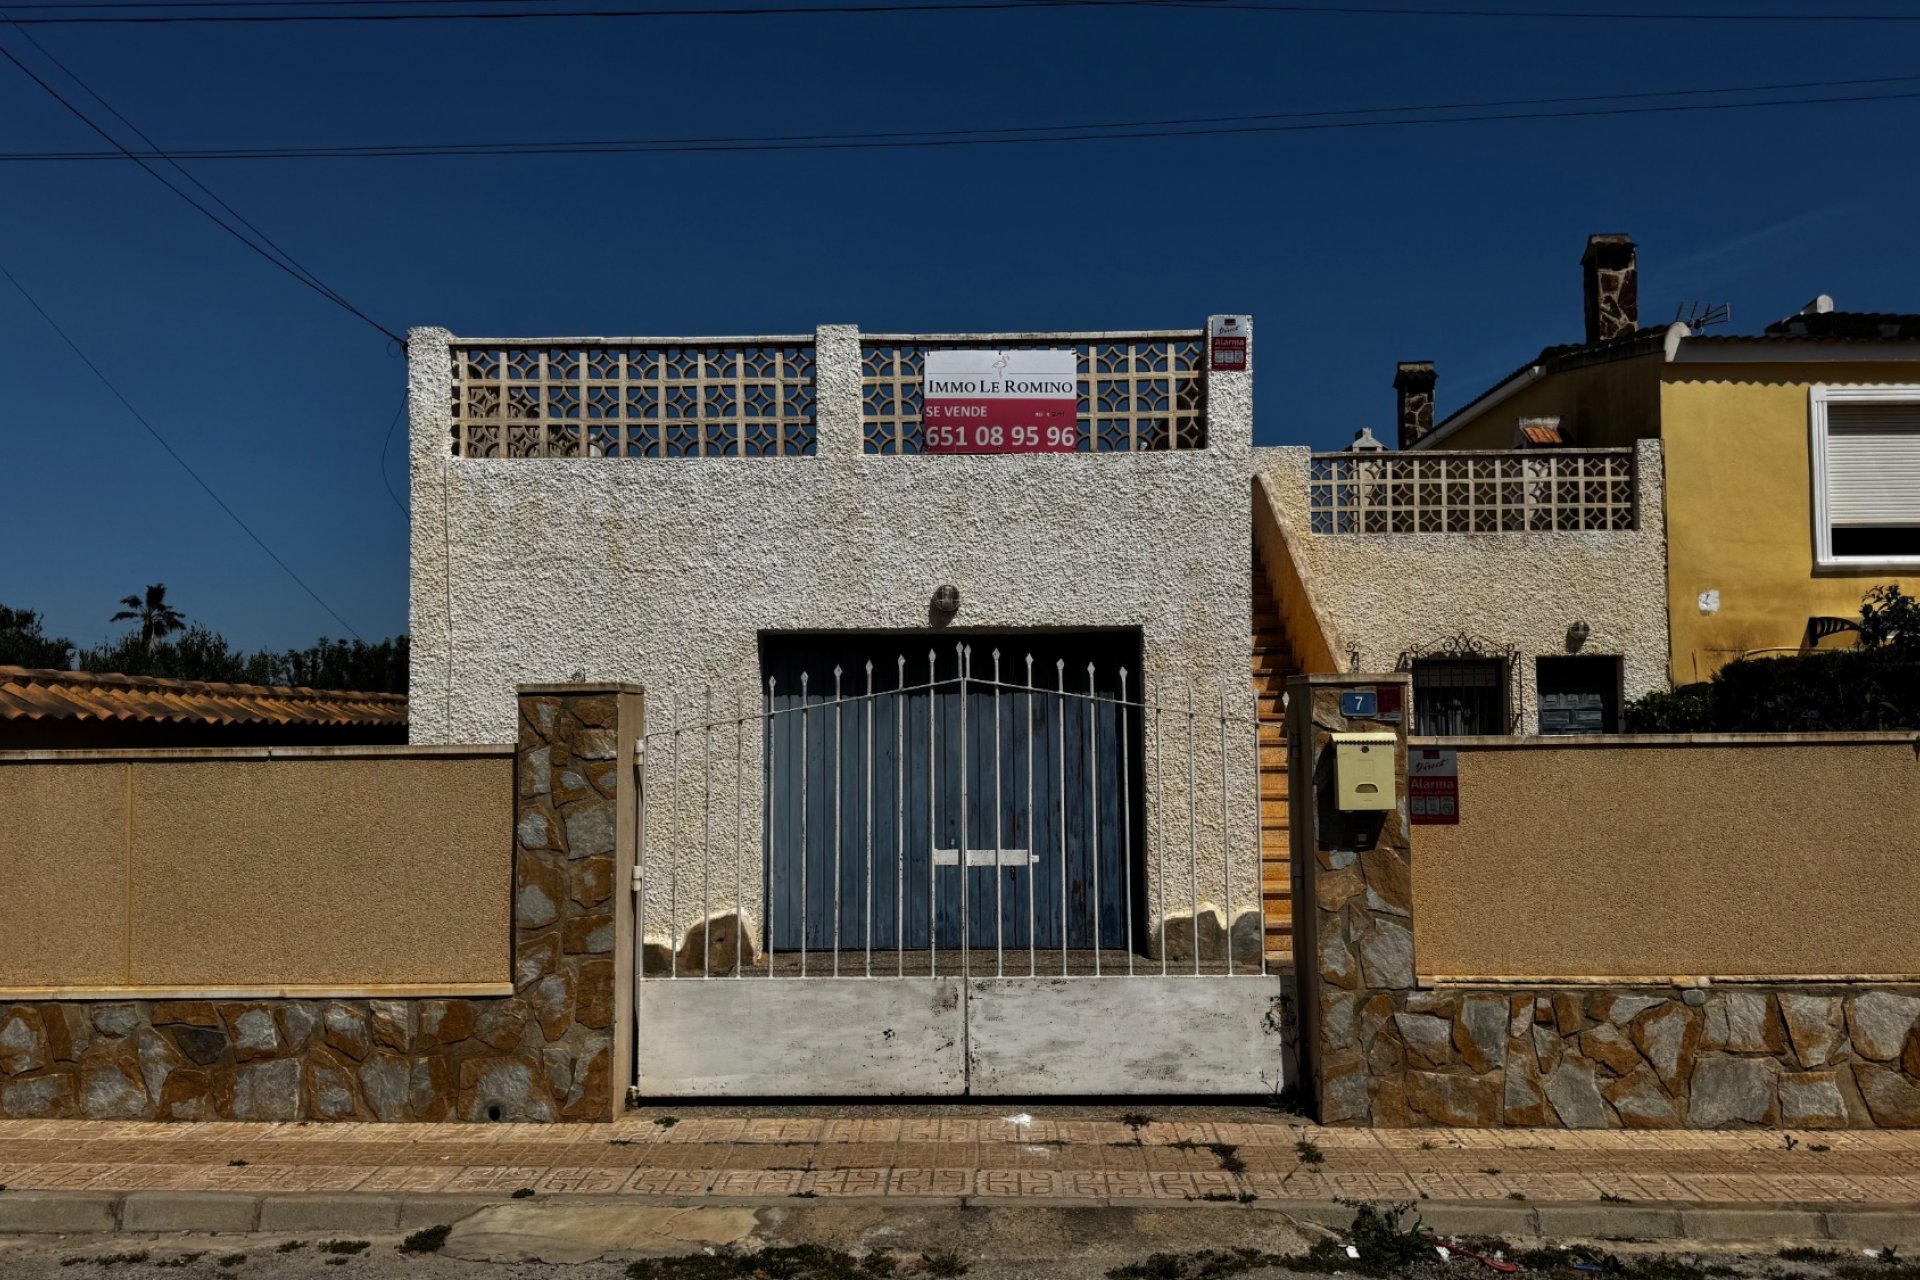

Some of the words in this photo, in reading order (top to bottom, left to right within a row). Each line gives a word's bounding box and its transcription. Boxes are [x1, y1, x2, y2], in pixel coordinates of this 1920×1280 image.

[1215, 338, 1244, 346] Alarma
[928, 380, 976, 394] IMMO
[980, 380, 1000, 394] LE
[1004, 380, 1073, 394] ROMINO
[926, 406, 941, 417] SE
[944, 406, 988, 417] VENDE
[926, 426, 968, 446] 651
[975, 426, 1004, 446] 08
[1011, 426, 1039, 446] 95
[1046, 426, 1075, 446] 96
[1354, 696, 1363, 711] 7
[1411, 778, 1454, 789] Alarma
